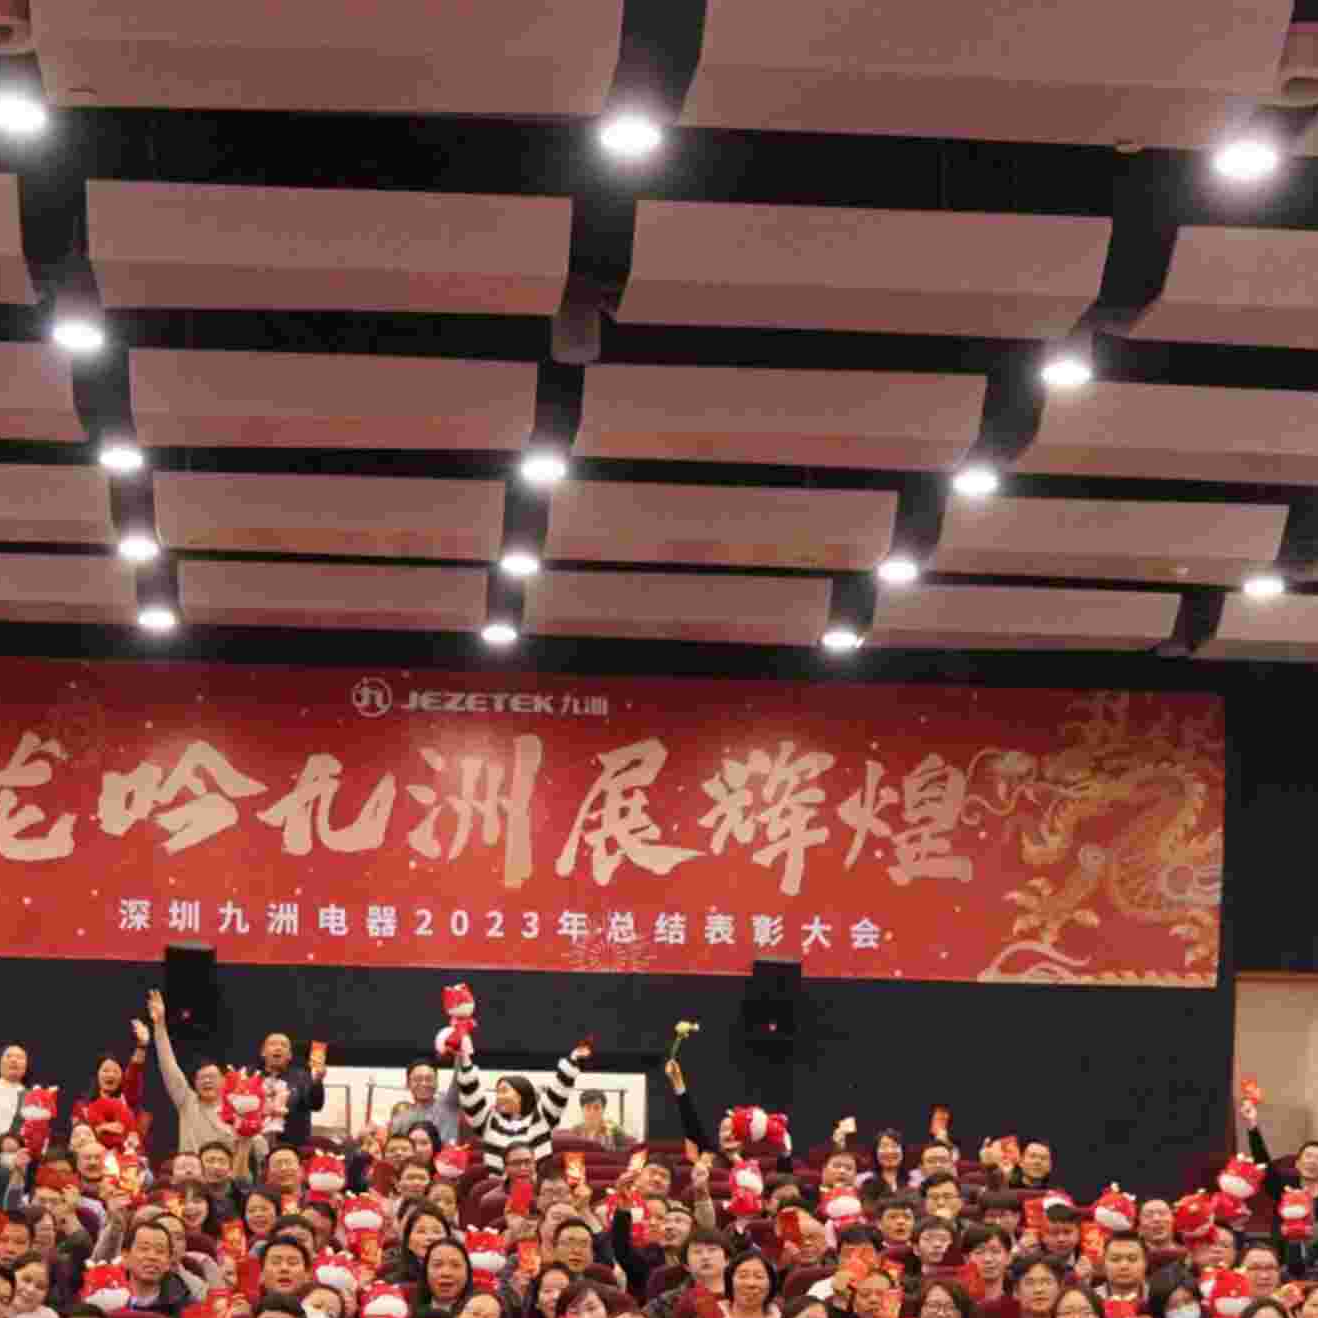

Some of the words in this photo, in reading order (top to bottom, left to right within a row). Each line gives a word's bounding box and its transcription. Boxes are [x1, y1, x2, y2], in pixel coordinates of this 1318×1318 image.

[401, 690, 554, 713] JEZETEK
[117, 898, 882, 950] 深圳九洲电器2023年总结表彰大会
